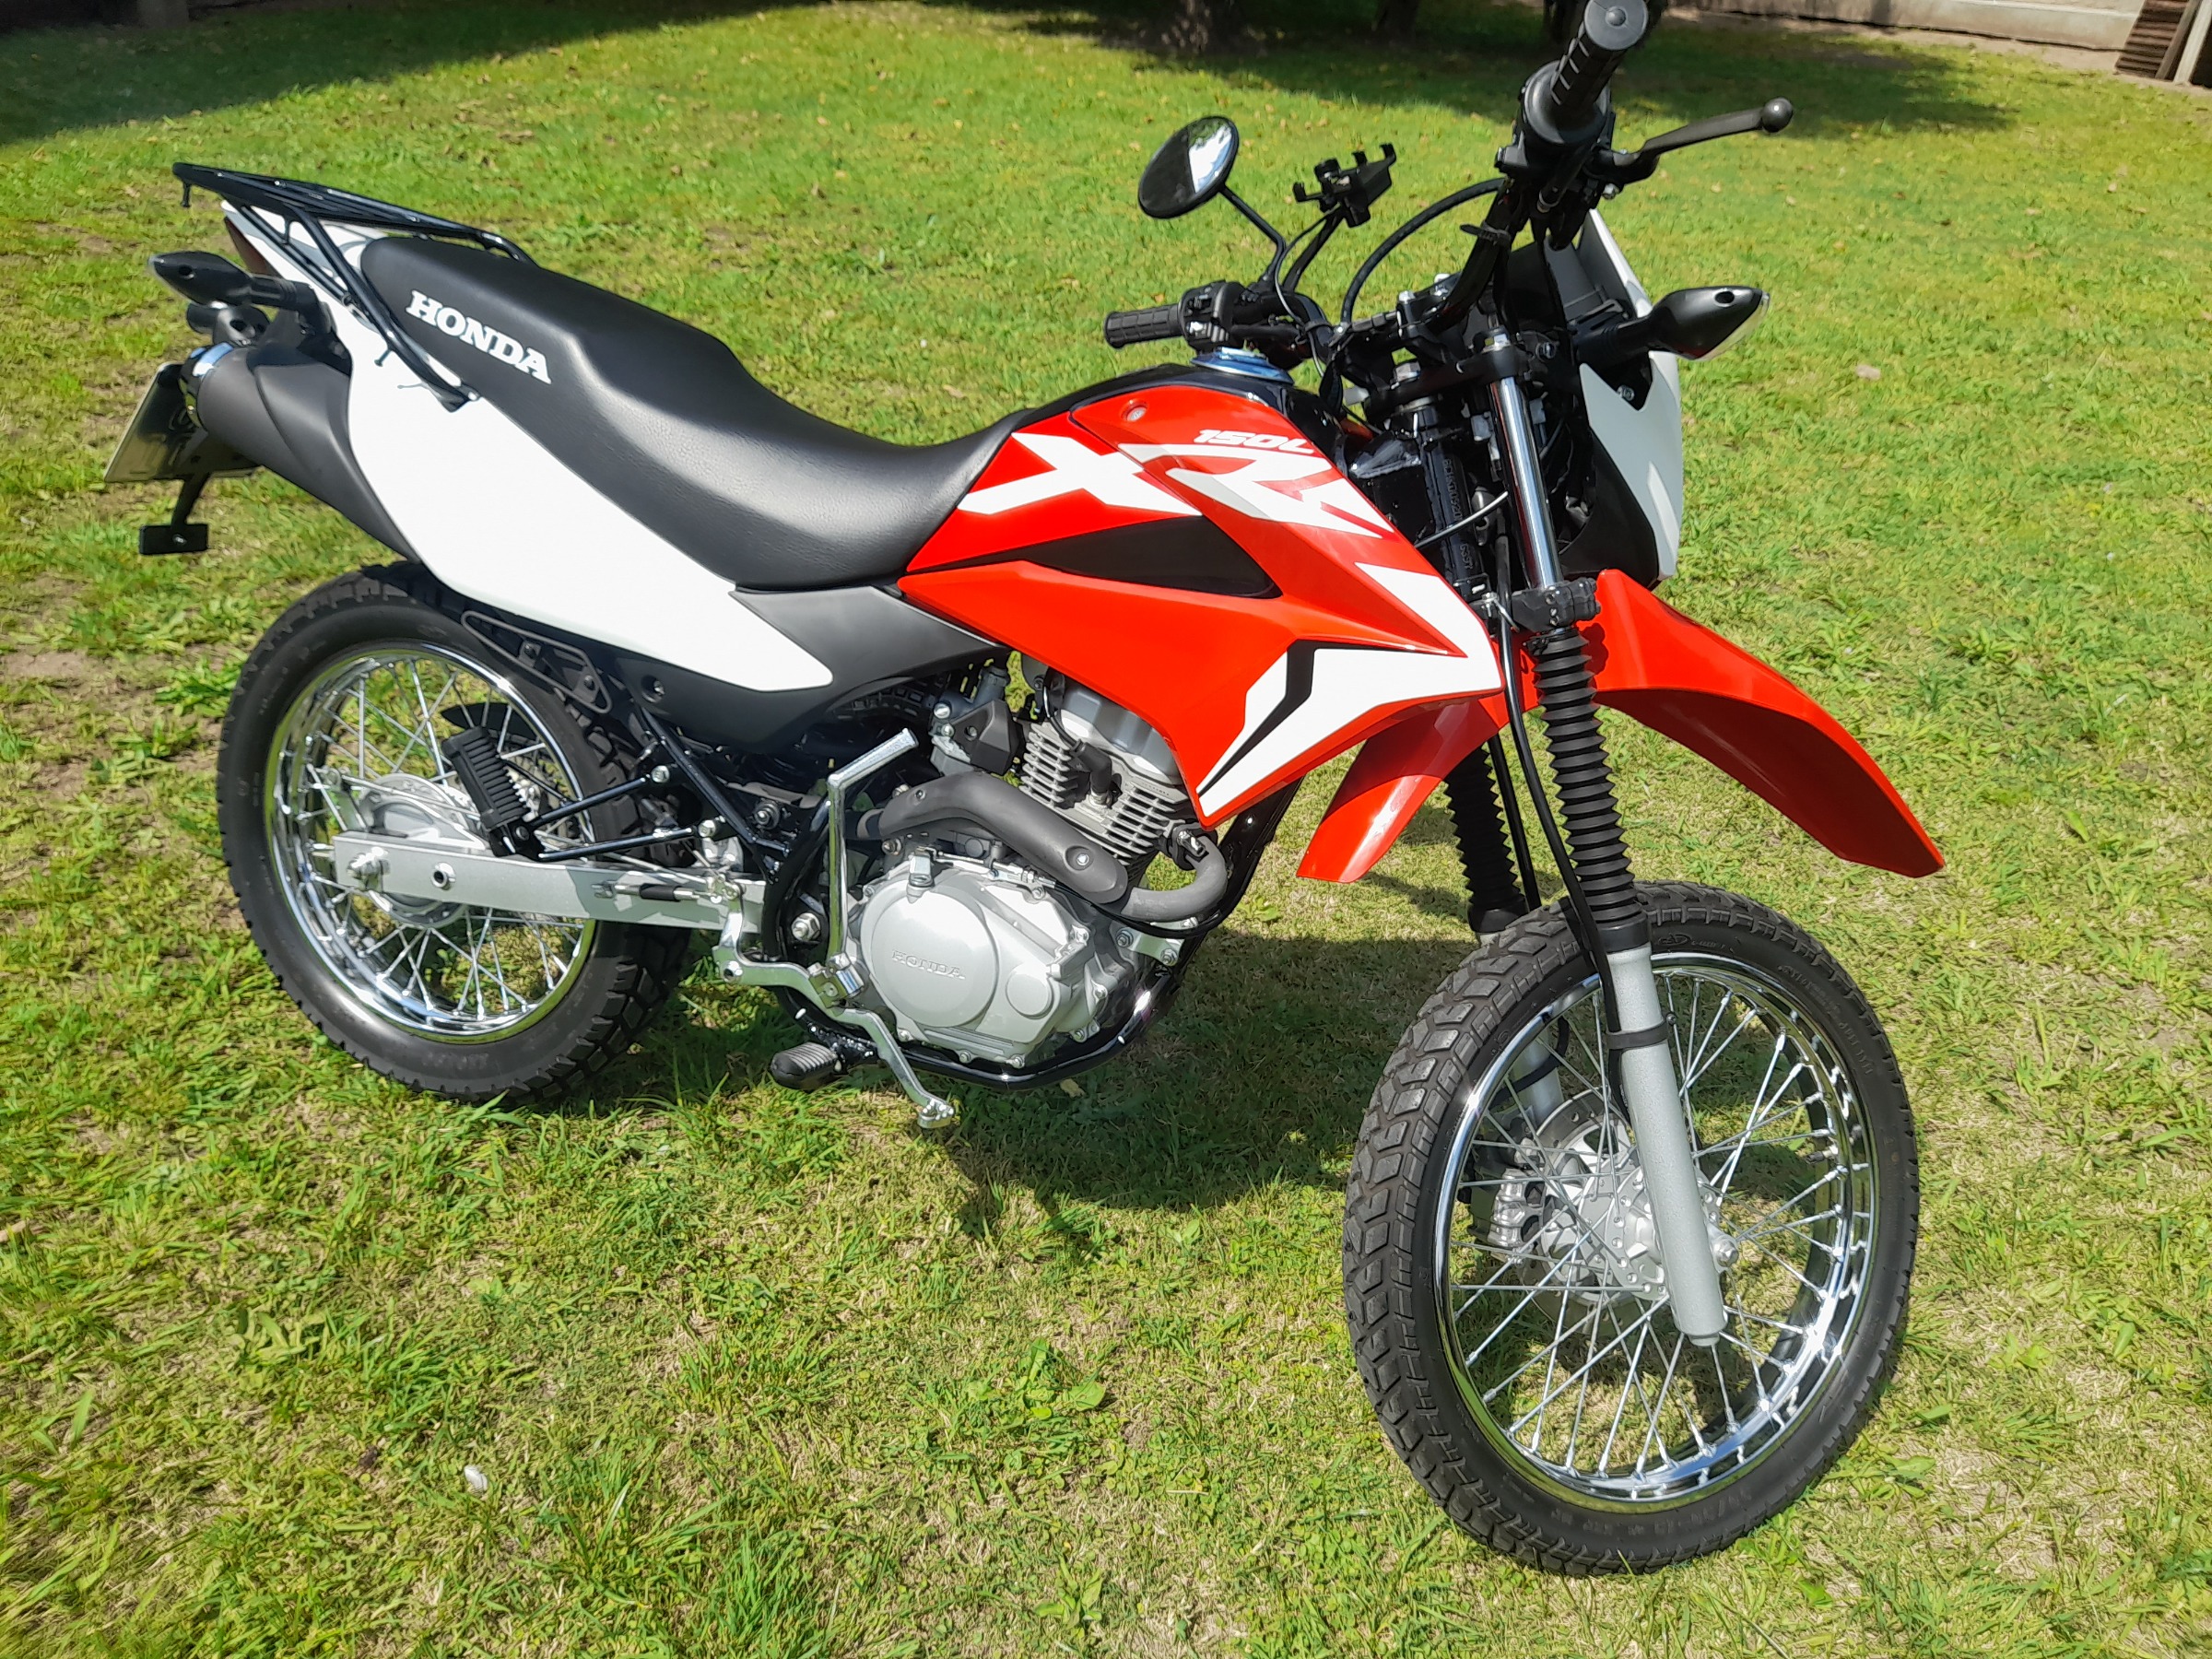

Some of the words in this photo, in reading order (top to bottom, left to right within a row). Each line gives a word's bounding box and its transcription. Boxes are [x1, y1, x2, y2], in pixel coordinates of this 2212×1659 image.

[406, 289, 552, 385] HONDA
[1193, 429, 1315, 454] 150L
[957, 431, 1394, 538] XR
[891, 949, 966, 980] HONDA
